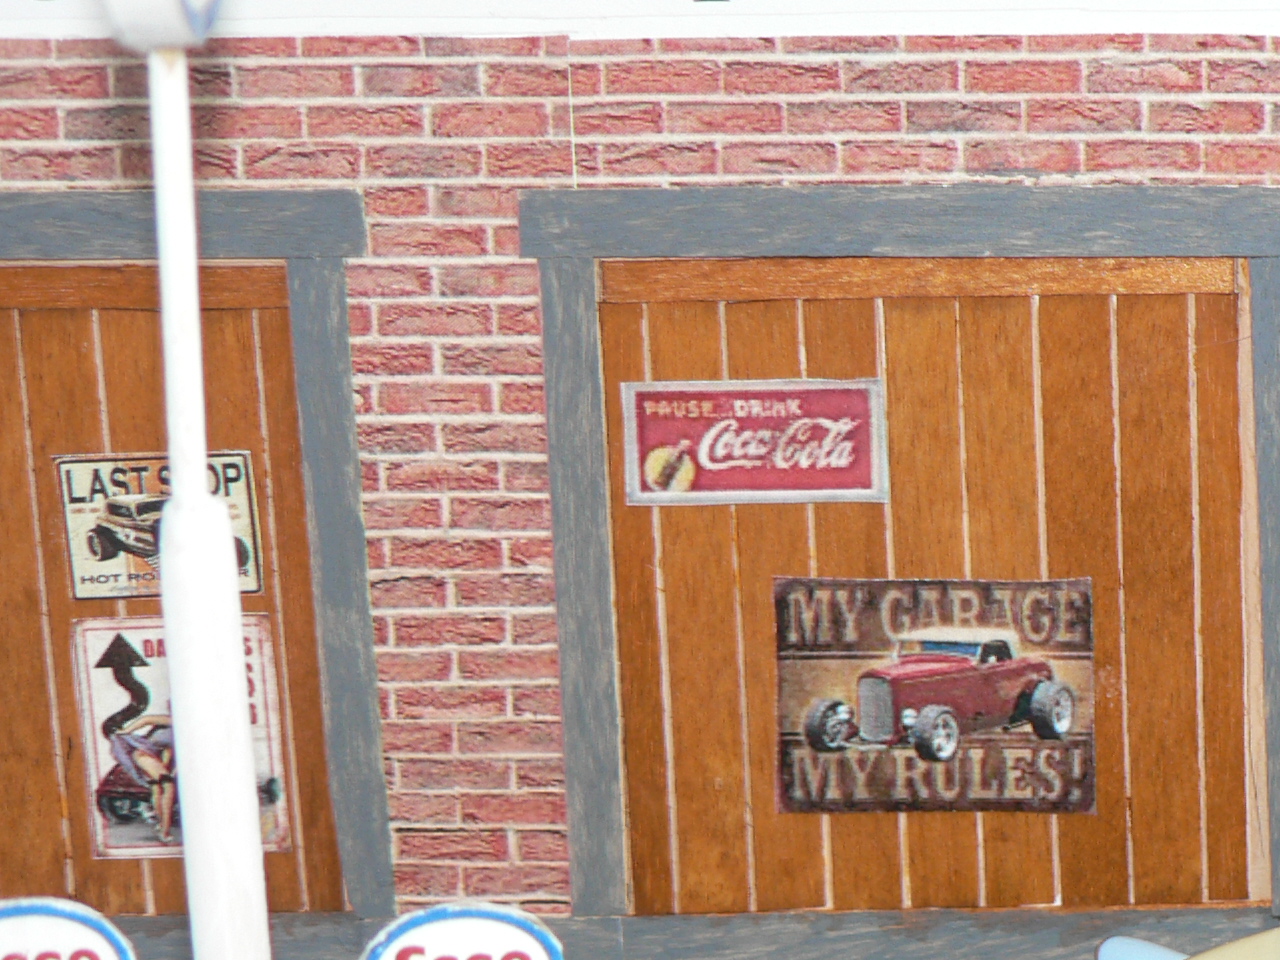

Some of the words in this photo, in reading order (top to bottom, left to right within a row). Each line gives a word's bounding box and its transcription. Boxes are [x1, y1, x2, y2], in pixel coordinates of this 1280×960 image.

[733, 398, 802, 418] DRINK
[697, 417, 862, 470] Coca-Cola
[65, 465, 150, 504] LAST
[158, 462, 242, 498] SOP
[80, 573, 121, 584] HOT
[787, 587, 865, 643] MY
[880, 585, 1091, 644] GARAGE
[792, 747, 876, 801] MY
[889, 747, 1084, 801] RULES!
